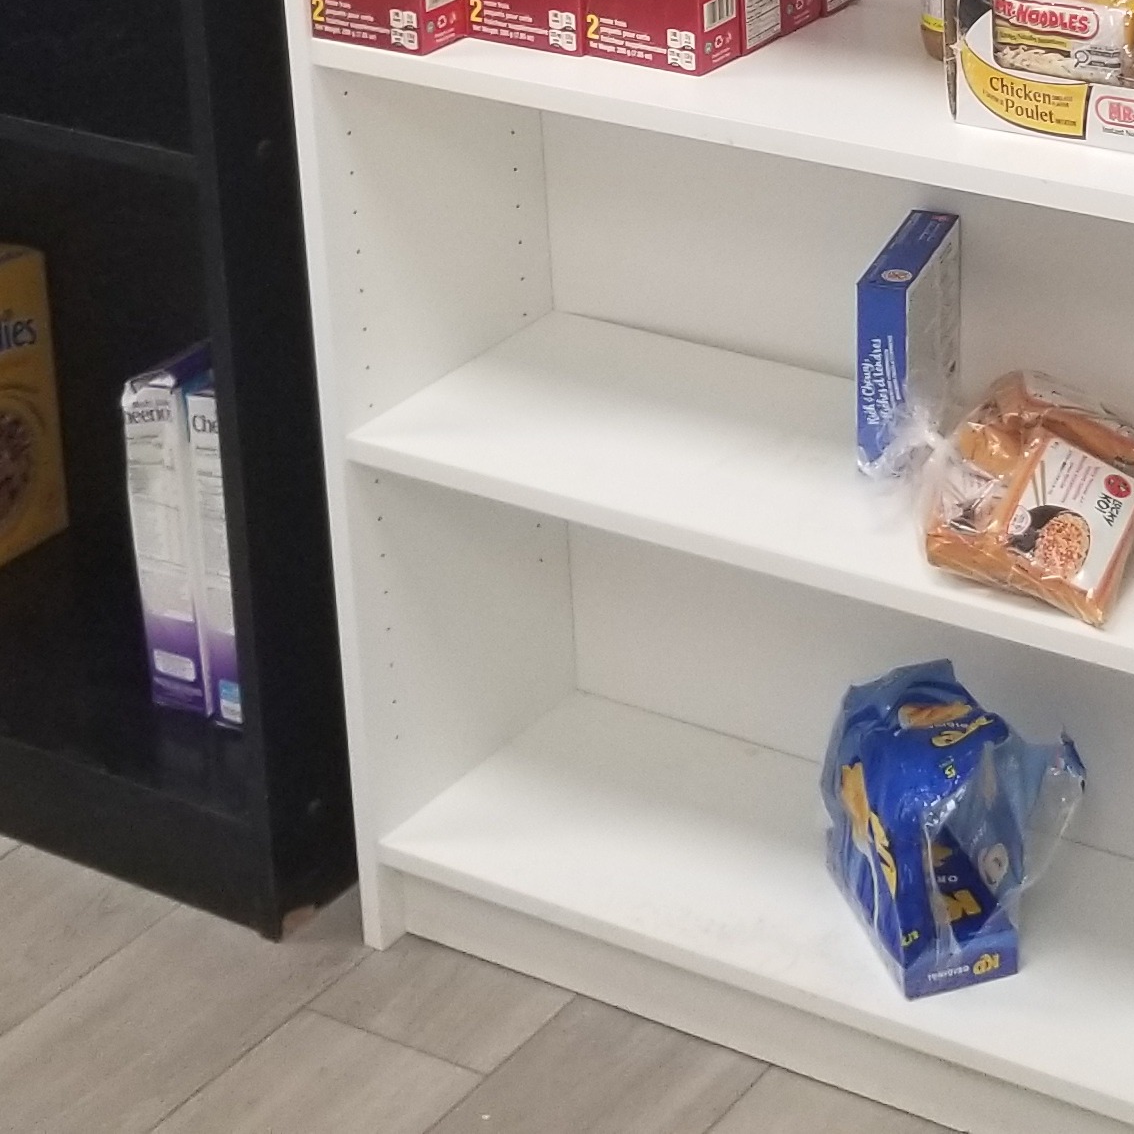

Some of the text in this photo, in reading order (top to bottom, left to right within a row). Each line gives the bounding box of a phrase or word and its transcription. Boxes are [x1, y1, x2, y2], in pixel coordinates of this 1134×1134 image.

[586, 14, 599, 40] 2
[1016, 5, 1089, 34] NOODLES
[988, 76, 1052, 106] Chicken
[1005, 98, 1054, 124] Poulet
